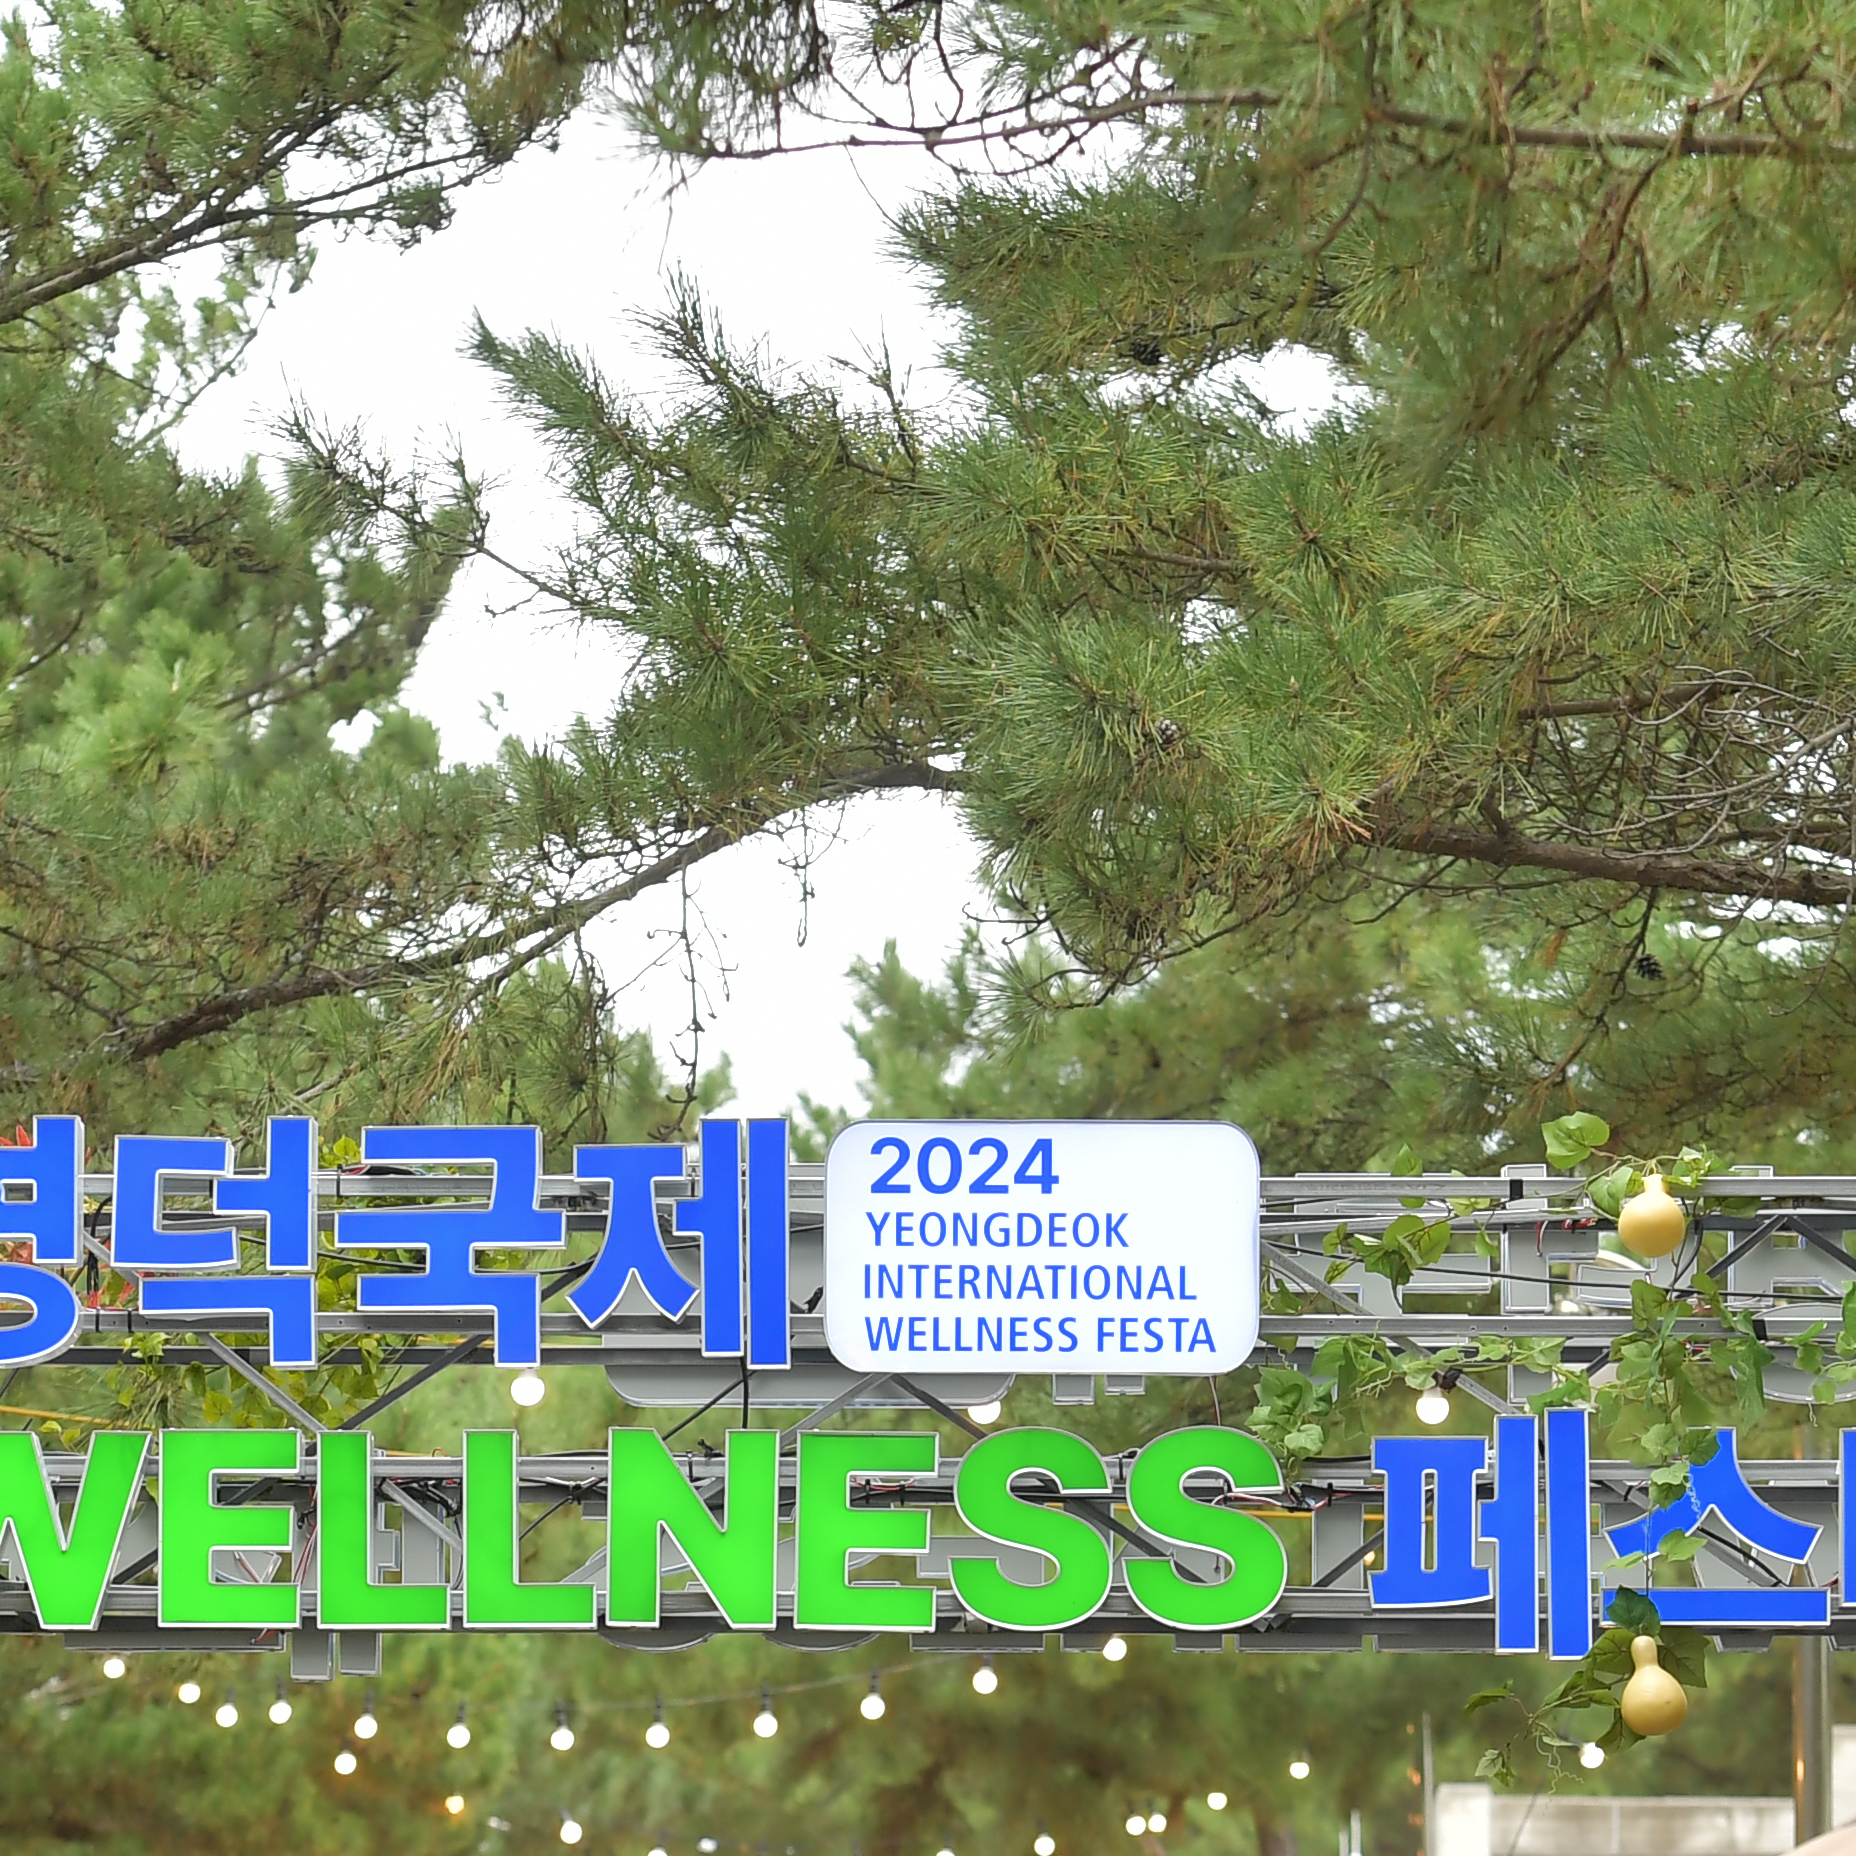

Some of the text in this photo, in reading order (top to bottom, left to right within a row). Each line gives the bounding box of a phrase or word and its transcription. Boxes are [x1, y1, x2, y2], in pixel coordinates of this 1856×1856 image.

[869, 1137, 1060, 1195] 2024
[865, 1211, 1130, 1248] YEONGDEOK
[863, 1263, 1197, 1300] INTERNATIONAL
[864, 1315, 1217, 1353] WELLNESS FESTA
